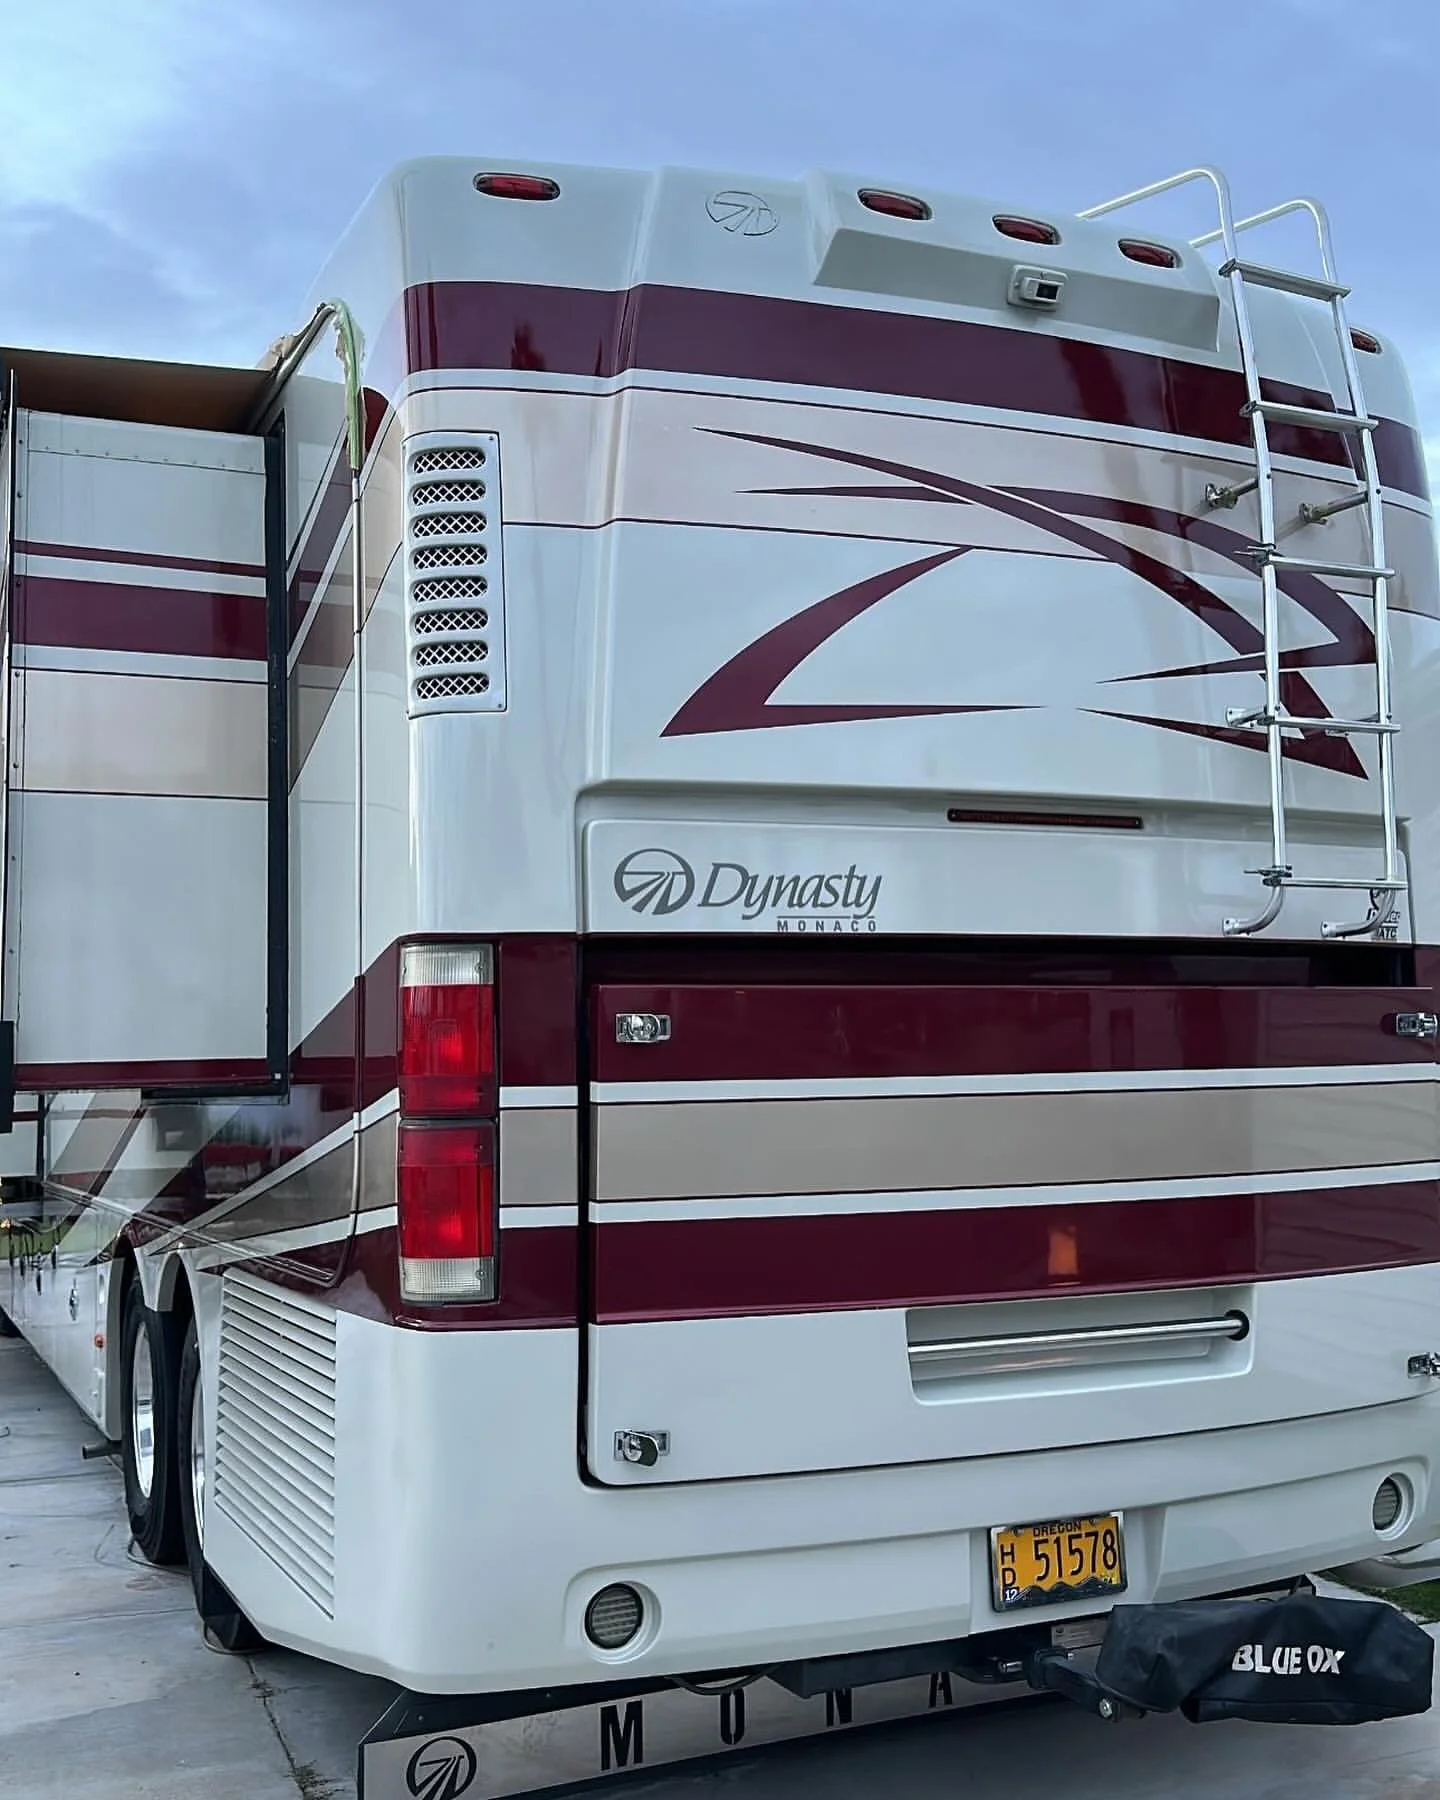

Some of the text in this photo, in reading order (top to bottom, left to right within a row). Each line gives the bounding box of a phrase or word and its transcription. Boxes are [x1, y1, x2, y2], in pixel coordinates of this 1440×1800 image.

[697, 862, 882, 920] Dynasty
[776, 919, 876, 932] MONACO
[1033, 1521, 1082, 1537] OREGON
[1033, 1529, 1117, 1581] 51578
[1231, 1644, 1345, 1675] BLUE OX
